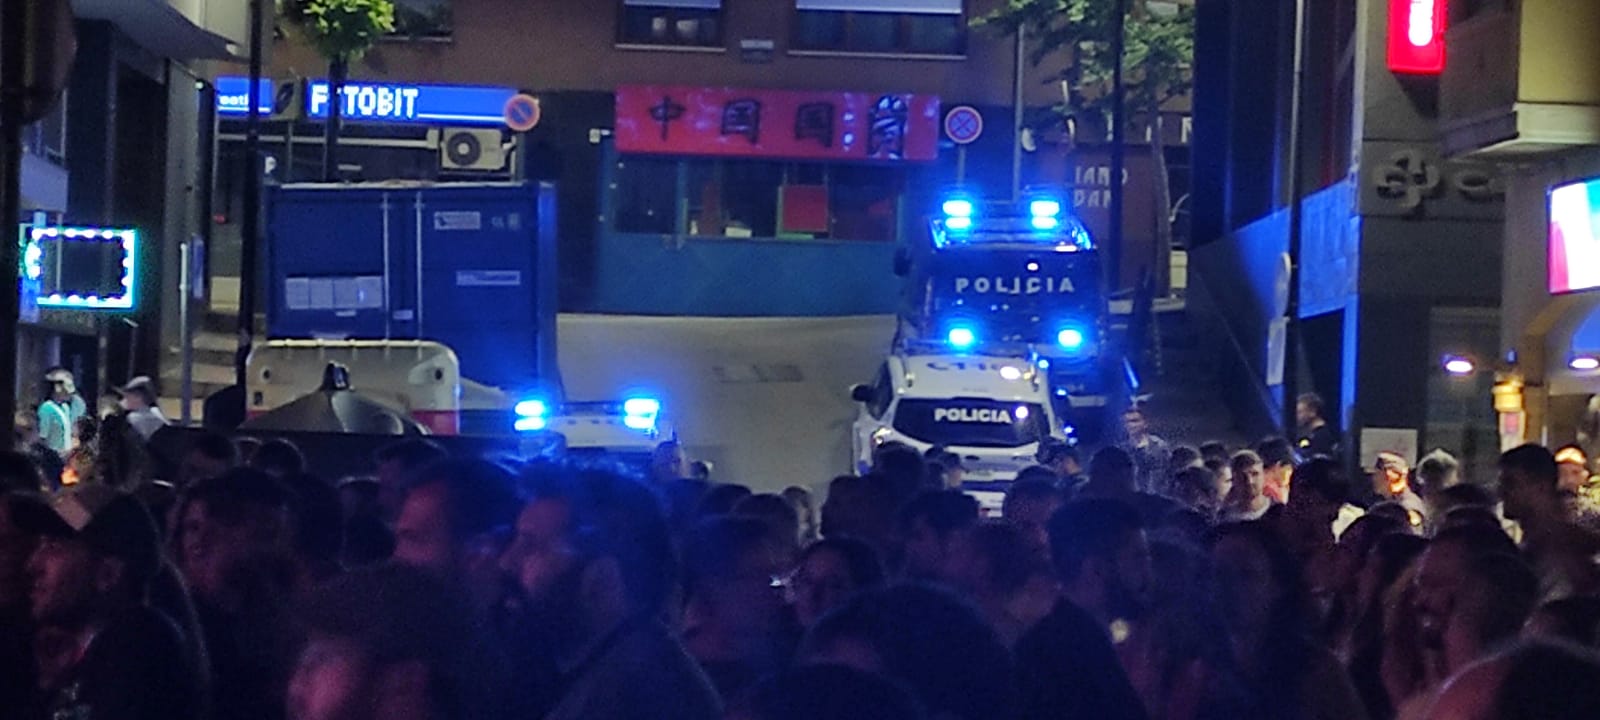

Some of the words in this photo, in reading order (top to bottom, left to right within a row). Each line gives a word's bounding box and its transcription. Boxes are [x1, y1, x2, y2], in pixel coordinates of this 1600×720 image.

[311, 84, 419, 118] FTOBIT
[955, 277, 1075, 294] POLICIA
[934, 407, 1012, 423] POLICIA
